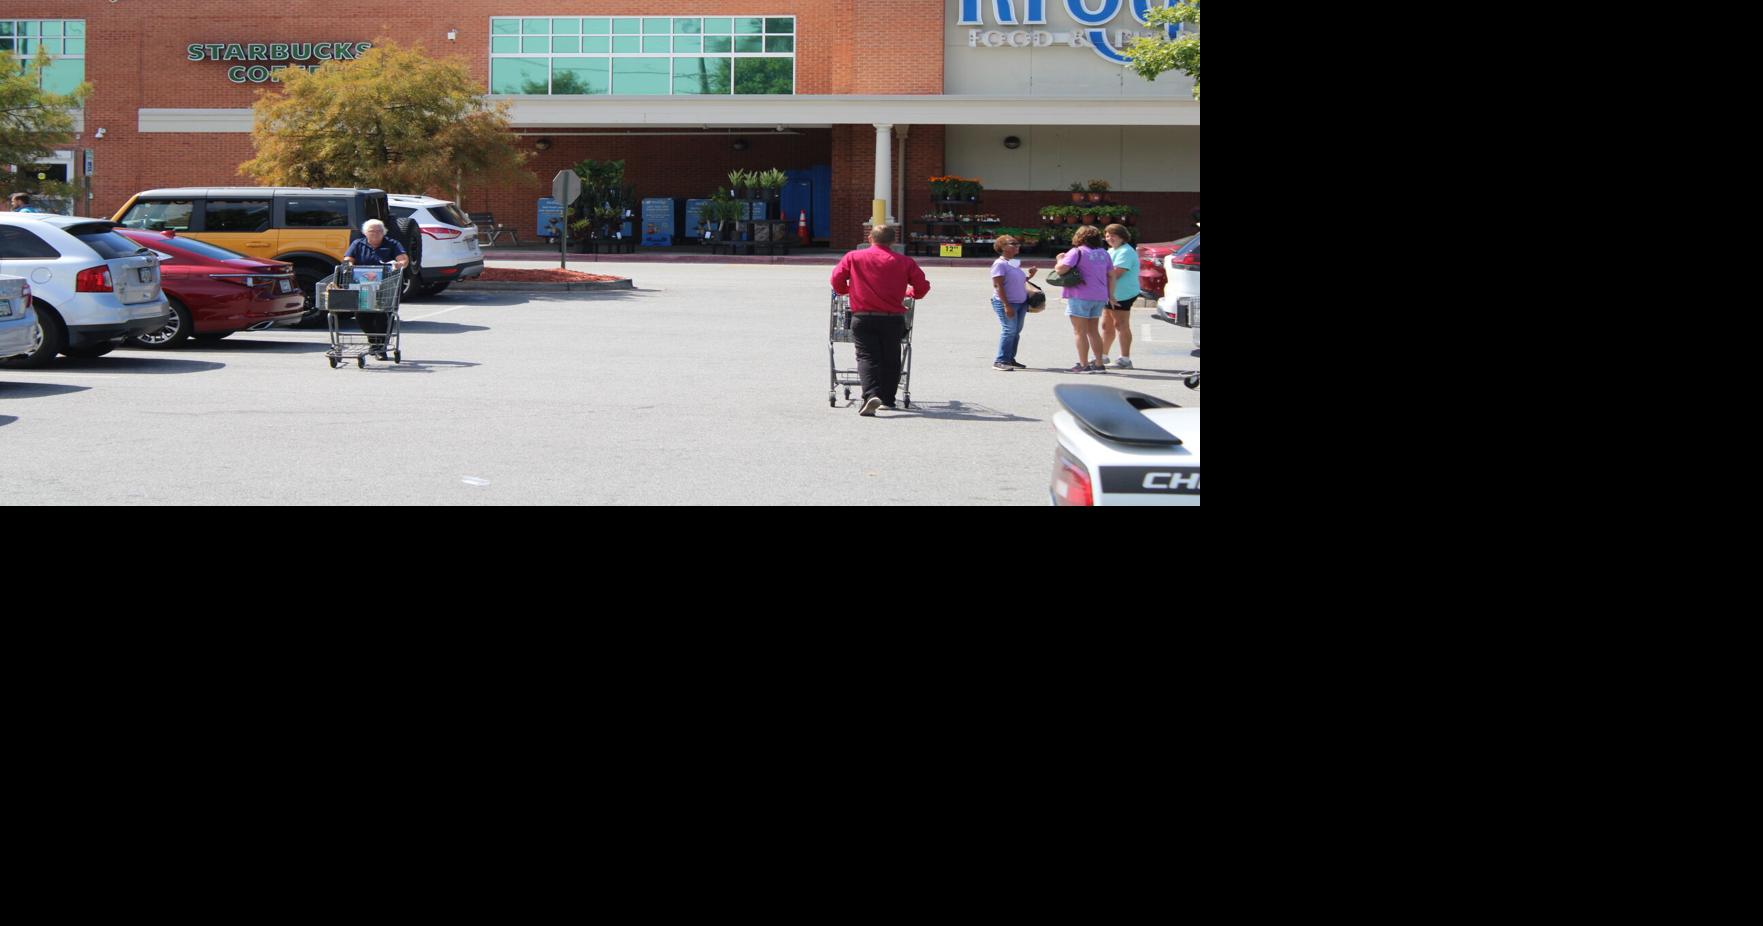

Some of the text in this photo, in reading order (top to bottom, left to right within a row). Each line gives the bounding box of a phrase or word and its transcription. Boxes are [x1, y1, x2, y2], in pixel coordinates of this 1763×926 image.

[968, 29, 1053, 47] FOOD
[187, 42, 371, 61] STARBUCKS
[1142, 472, 1200, 490] CH
